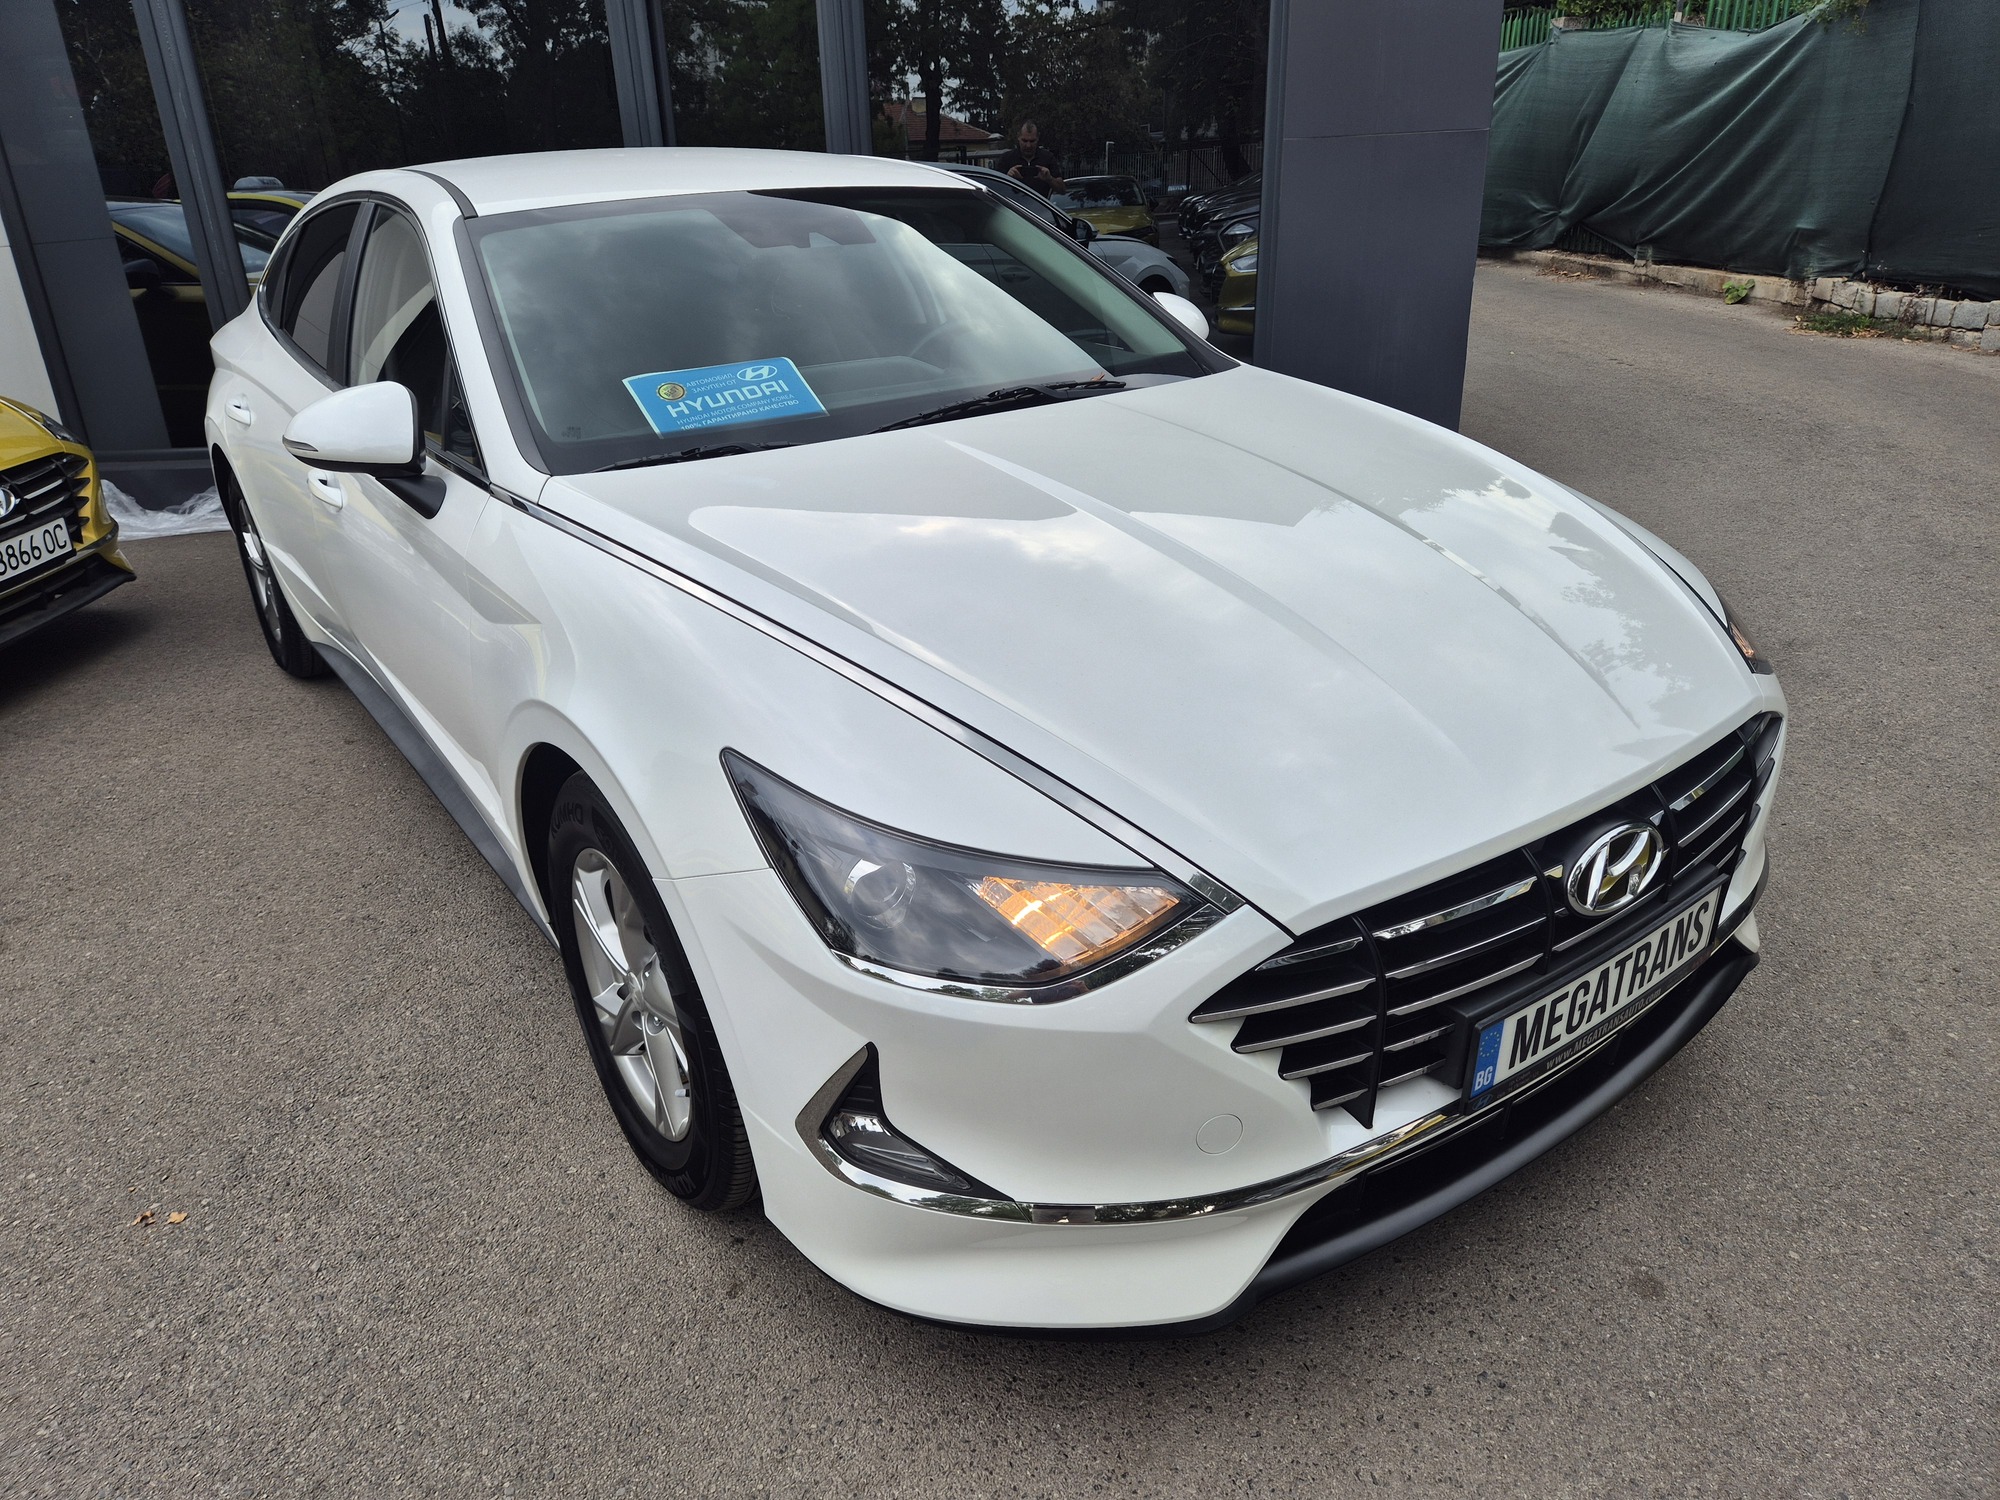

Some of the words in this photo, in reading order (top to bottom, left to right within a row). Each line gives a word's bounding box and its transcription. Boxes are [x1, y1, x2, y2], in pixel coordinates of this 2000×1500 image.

[666, 379, 790, 418] HYUNDAI
[691, 381, 726, 394] ЗАКУПЕН
[676, 412, 710, 425] HYUNDAI
[711, 405, 737, 417] MOTOR
[736, 398, 771, 411] COMPANY
[770, 393, 795, 403] KOREA
[680, 421, 702, 431] 100%
[702, 408, 759, 426] ГАРАНТИРАНО
[759, 399, 799, 412] КАЧЕСТВО
[42, 523, 67, 555] OC
[1507, 900, 1710, 1070] MEGATRANS
[1473, 1064, 1494, 1091] BG
